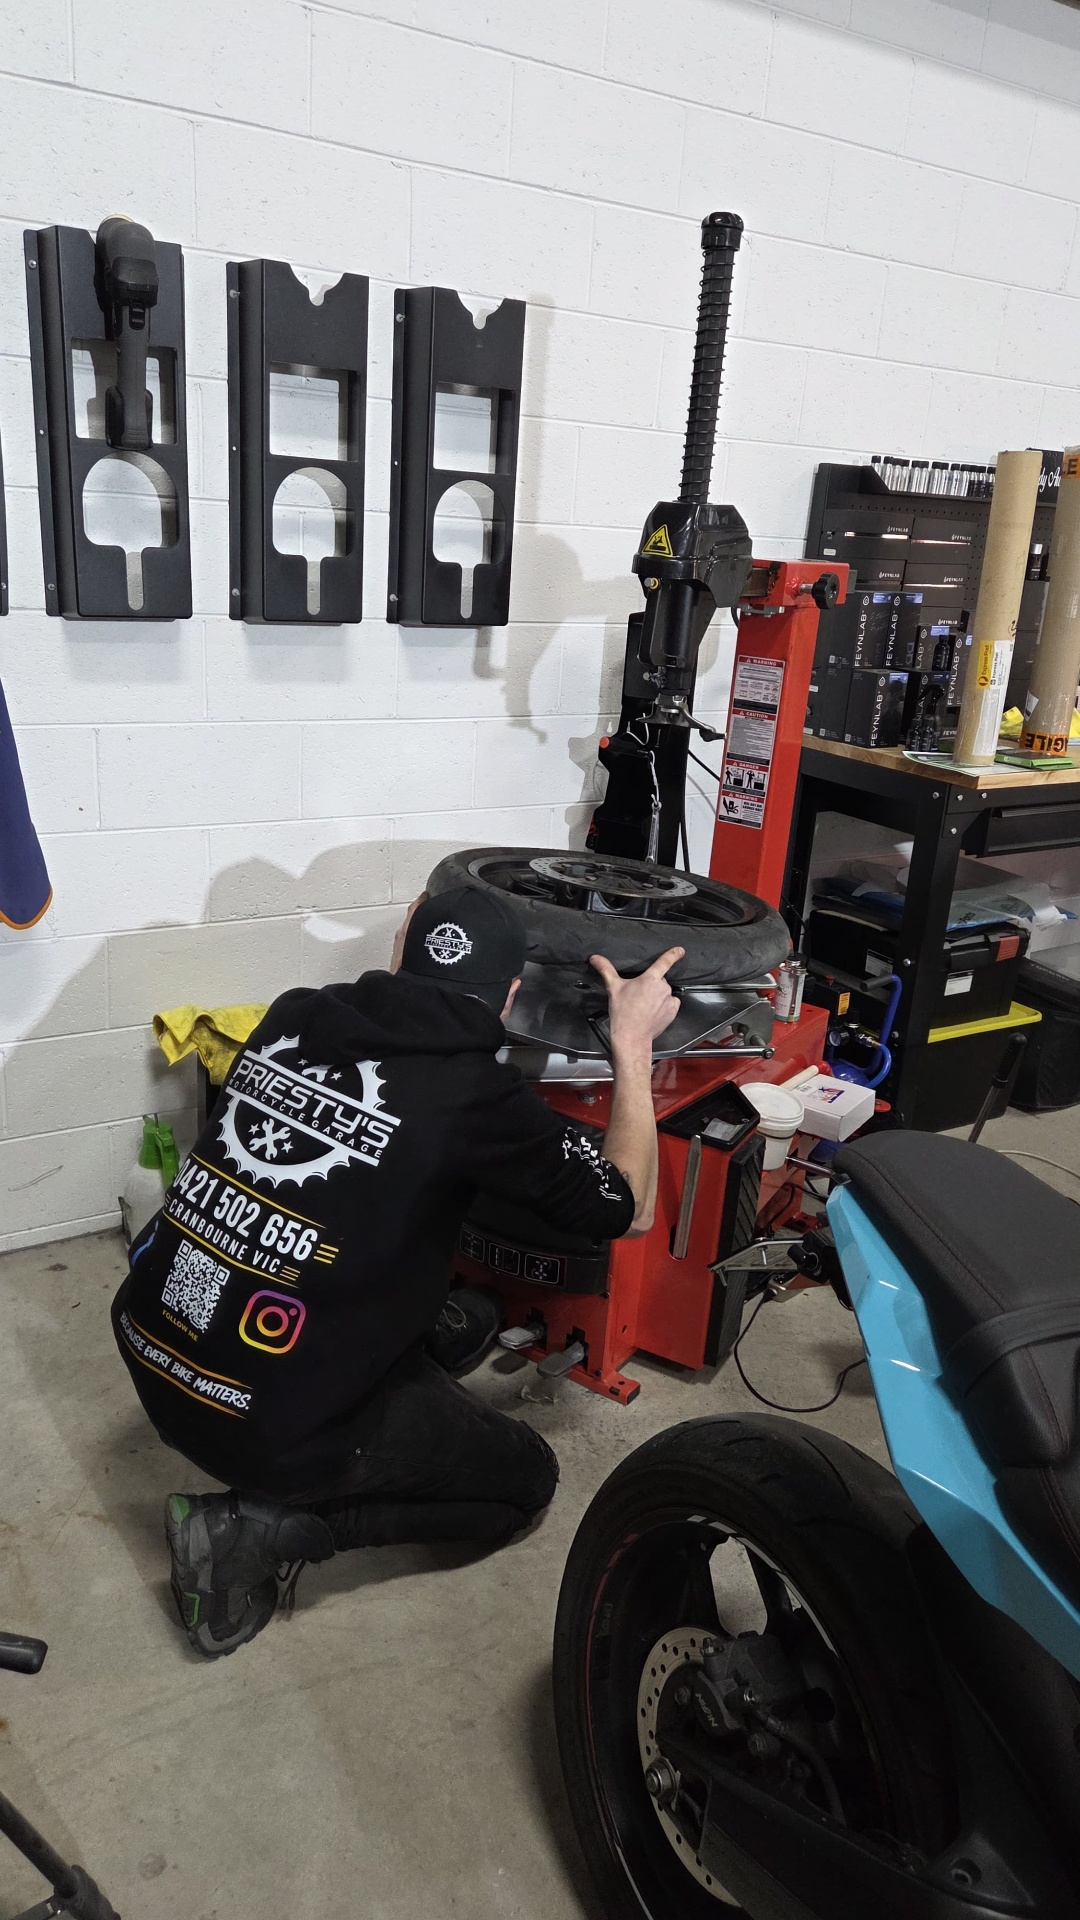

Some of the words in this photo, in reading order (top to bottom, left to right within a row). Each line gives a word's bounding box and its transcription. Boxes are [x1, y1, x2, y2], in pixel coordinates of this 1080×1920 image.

[752, 658, 777, 667] WARNING
[854, 613, 868, 667] FEYNLAB
[885, 613, 899, 667] FEYNLAB
[947, 655, 960, 705] FEYNLAB
[745, 711, 769, 719] CAUTION
[870, 694, 883, 747] FEYNLAB
[228, 1078, 306, 1122] MOTORCYCLE
[311, 1121, 383, 1159] GARAGE
[232, 1058, 394, 1149] PRIESTY'S
[168, 1198, 249, 1261] CRANBOURNE
[252, 1249, 281, 1273] VIC
[173, 1158, 219, 1210] 0421
[213, 1185, 261, 1238] 502
[259, 1213, 319, 1261] 656
[162, 1309, 189, 1334] FOLLOW
[188, 1330, 199, 1342] ME
[119, 1311, 146, 1351] BECAUSE
[143, 1345, 172, 1369] EVERY
[171, 1361, 195, 1383] BIKE
[192, 1377, 252, 1410] MATTERS.
